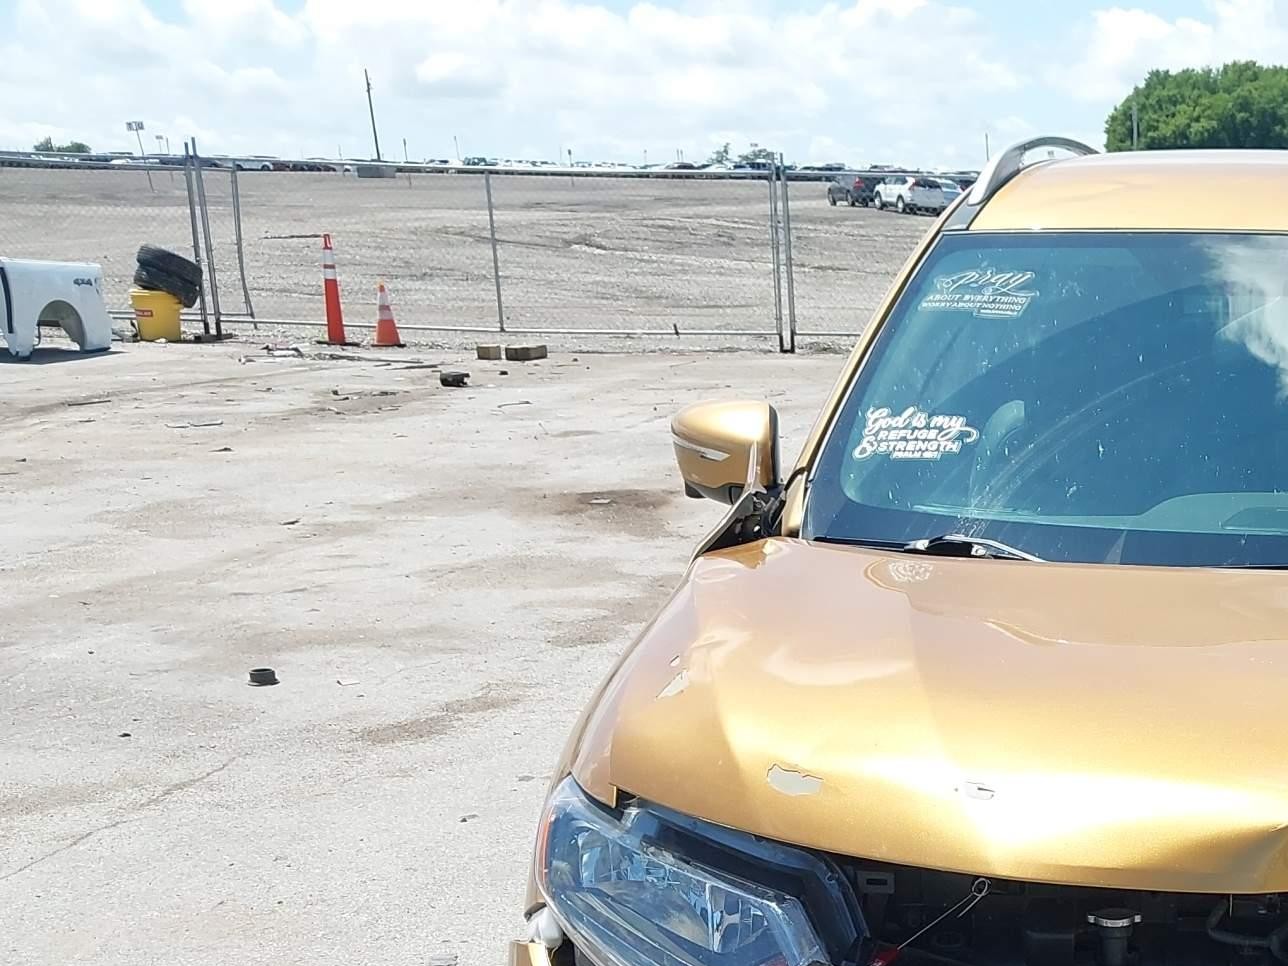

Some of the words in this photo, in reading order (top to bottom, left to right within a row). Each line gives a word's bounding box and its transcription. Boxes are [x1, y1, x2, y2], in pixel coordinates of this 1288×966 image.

[865, 406, 915, 435] God
[877, 429, 938, 441] REFUGE
[879, 440, 960, 452] STRENGTH
